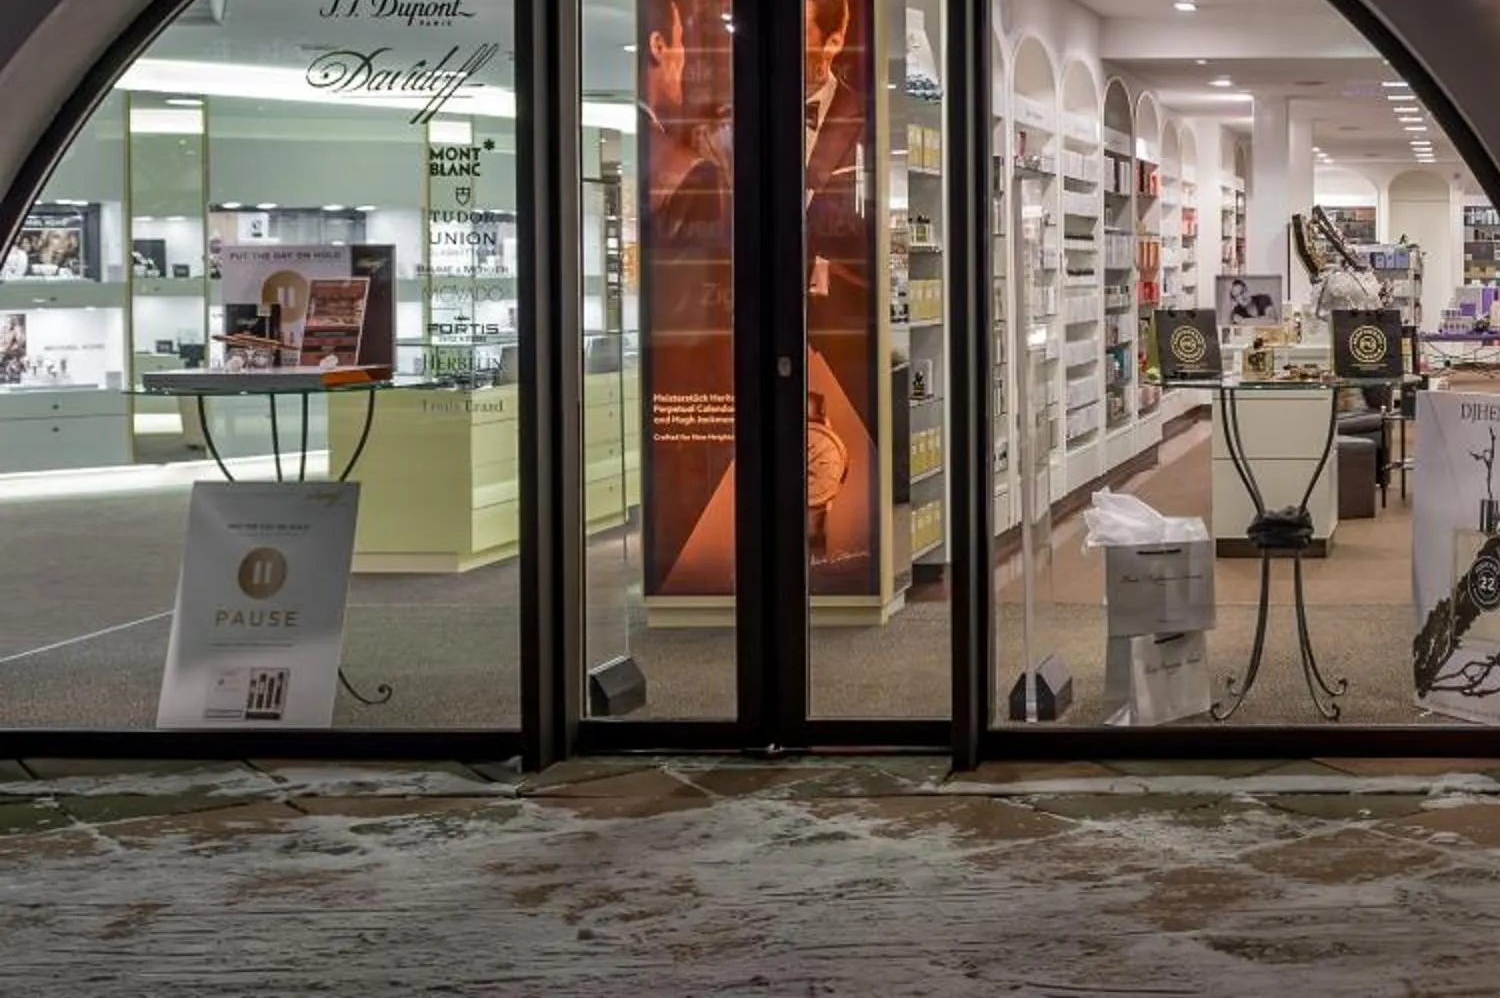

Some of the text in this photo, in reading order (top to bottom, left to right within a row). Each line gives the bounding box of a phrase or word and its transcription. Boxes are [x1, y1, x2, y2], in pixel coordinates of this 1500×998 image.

[306, 43, 499, 124] Davidoff
[429, 147, 482, 161] MONT
[429, 163, 482, 177] BLANC
[430, 210, 496, 223] TUDOR
[430, 231, 497, 245] UNION
[427, 322, 500, 335] FORTIS
[1480, 576, 1496, 592] 22
[215, 609, 299, 628] PAUSE
